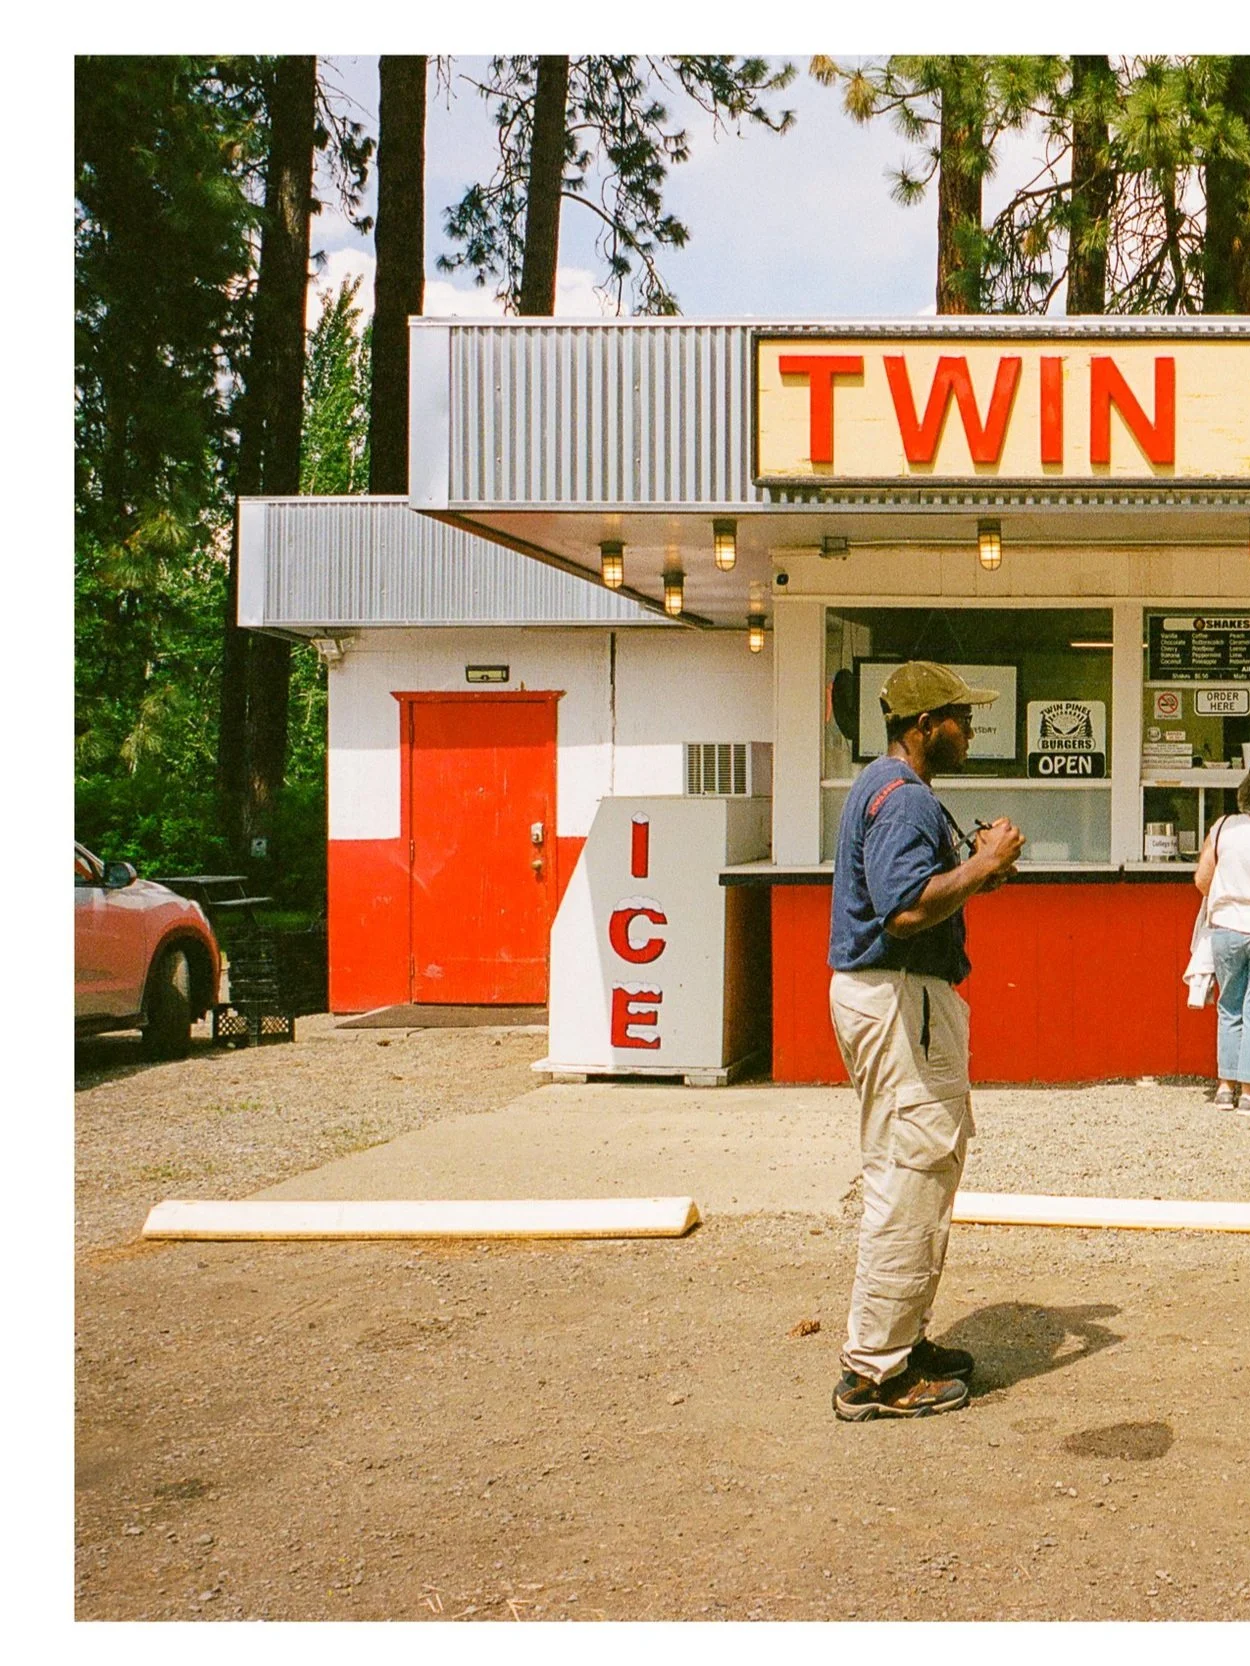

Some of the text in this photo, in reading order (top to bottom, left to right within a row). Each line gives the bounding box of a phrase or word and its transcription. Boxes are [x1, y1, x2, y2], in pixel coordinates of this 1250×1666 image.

[778, 354, 1176, 466] TWIN
[1206, 620, 1250, 629] SHAKES
[1207, 692, 1239, 701] ORDER
[1040, 703, 1063, 715] TWIN
[1210, 702, 1235, 711] HERE
[1041, 740, 1092, 750] BURGERS
[1038, 756, 1092, 775] OPEN
[609, 810, 668, 1049] ICE
